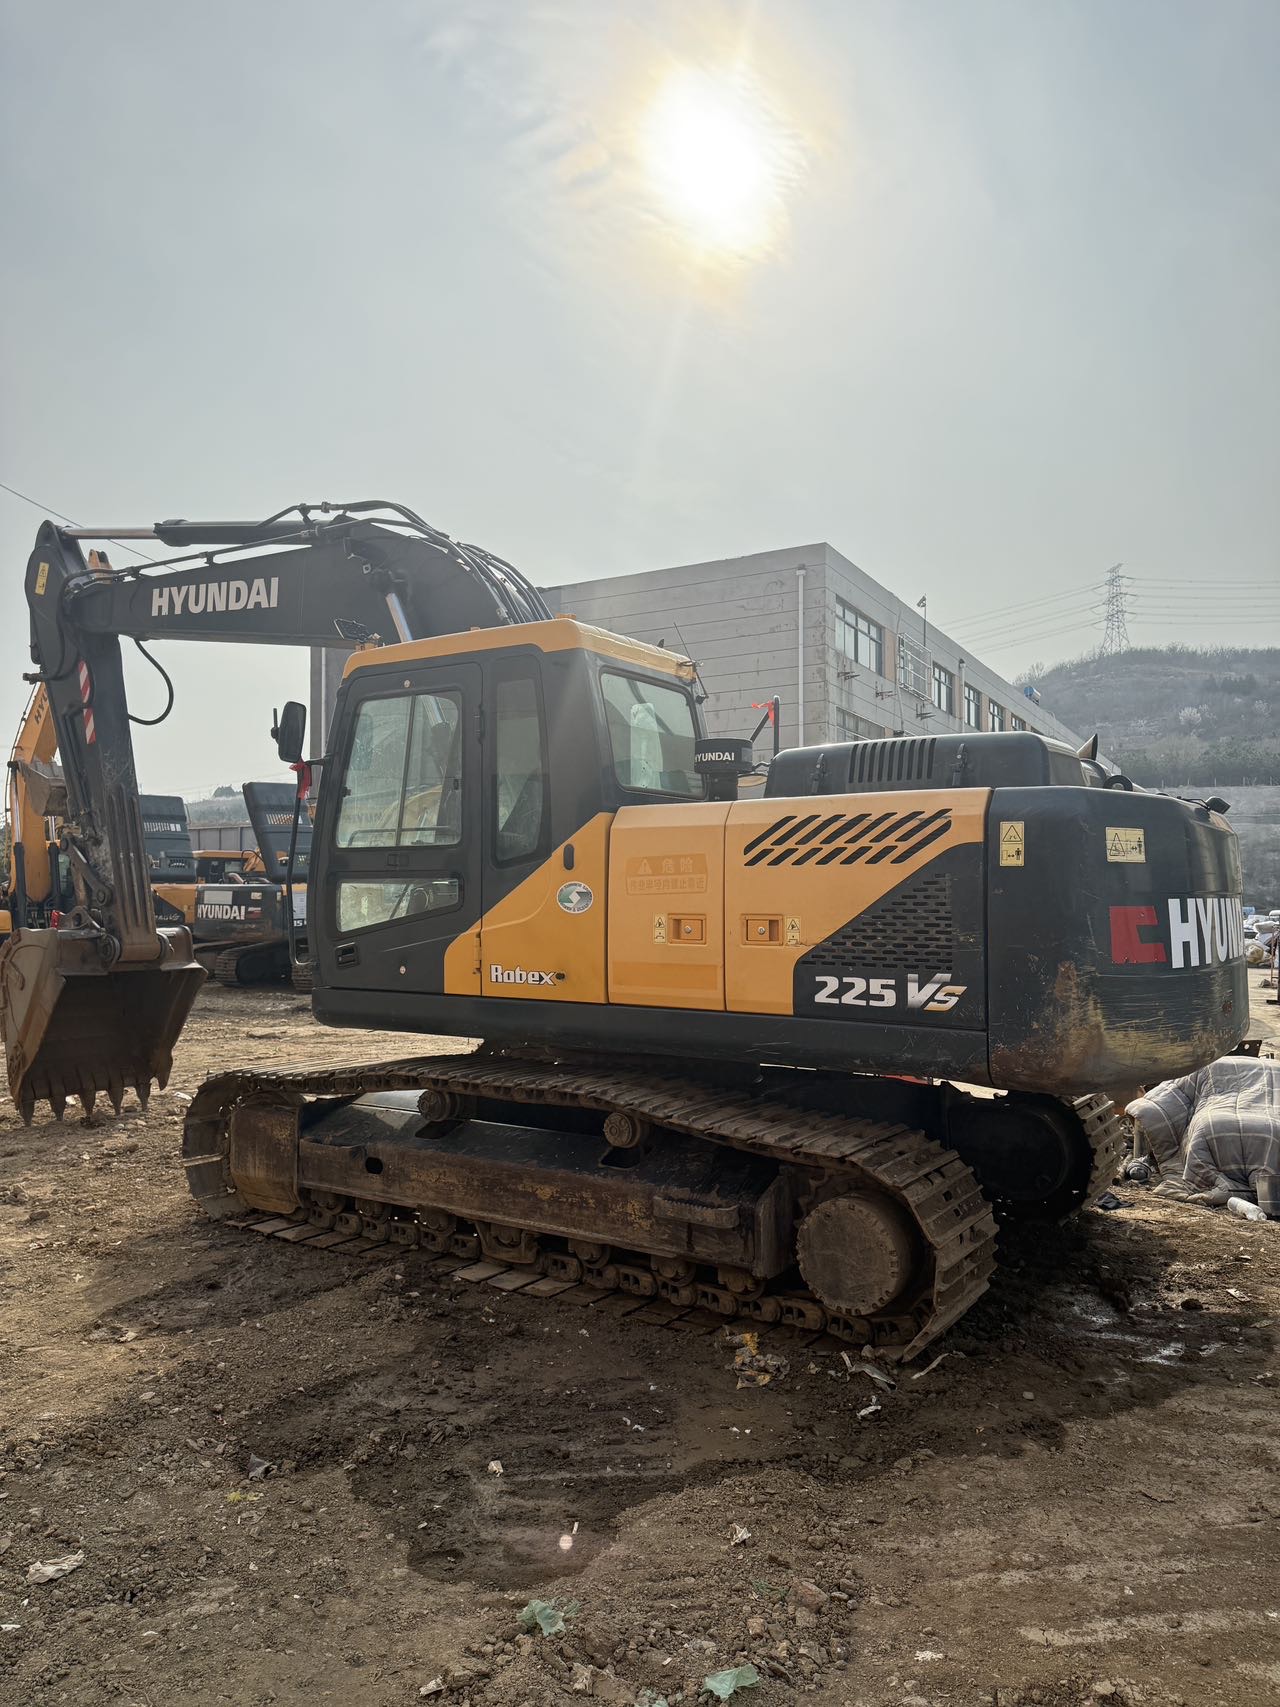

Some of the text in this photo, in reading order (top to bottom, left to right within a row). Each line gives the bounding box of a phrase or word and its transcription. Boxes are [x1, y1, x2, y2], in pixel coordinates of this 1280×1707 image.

[151, 577, 279, 617] HYUNDAI
[197, 904, 246, 920] HYUNDAI
[489, 964, 557, 986] Robex
[814, 975, 897, 1008] 225
